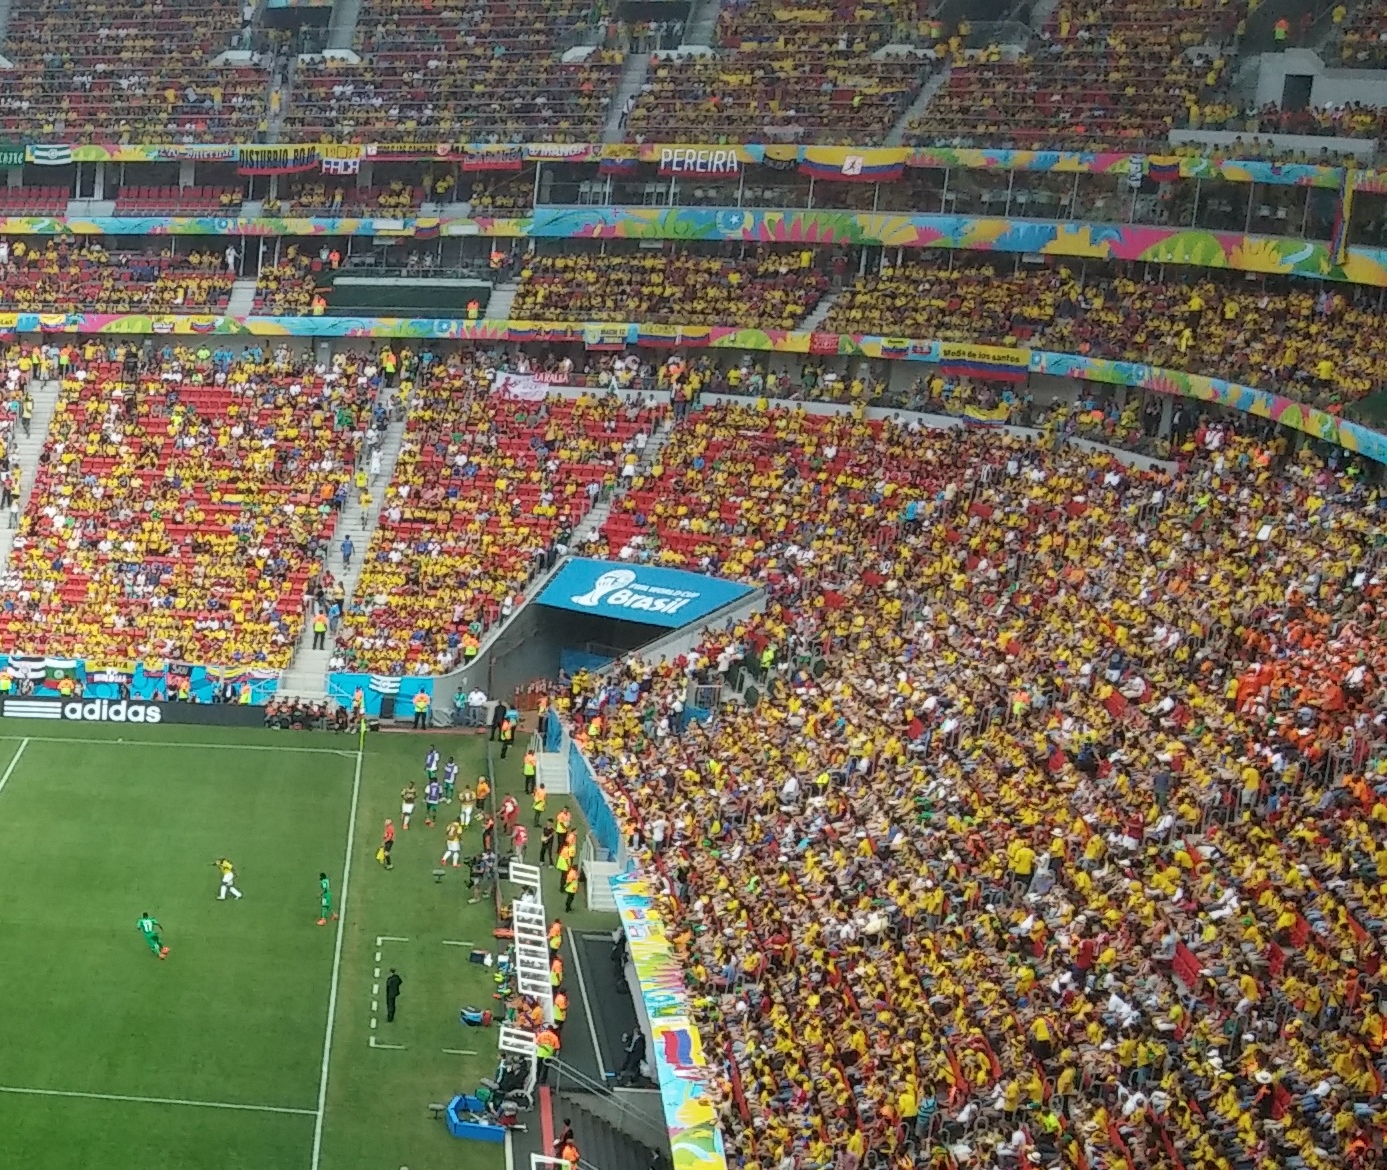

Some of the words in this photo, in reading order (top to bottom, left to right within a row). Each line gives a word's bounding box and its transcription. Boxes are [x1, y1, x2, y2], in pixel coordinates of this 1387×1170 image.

[660, 149, 738, 173] PEREIRA
[607, 588, 691, 614] Brasil
[64, 699, 162, 723] adidas
